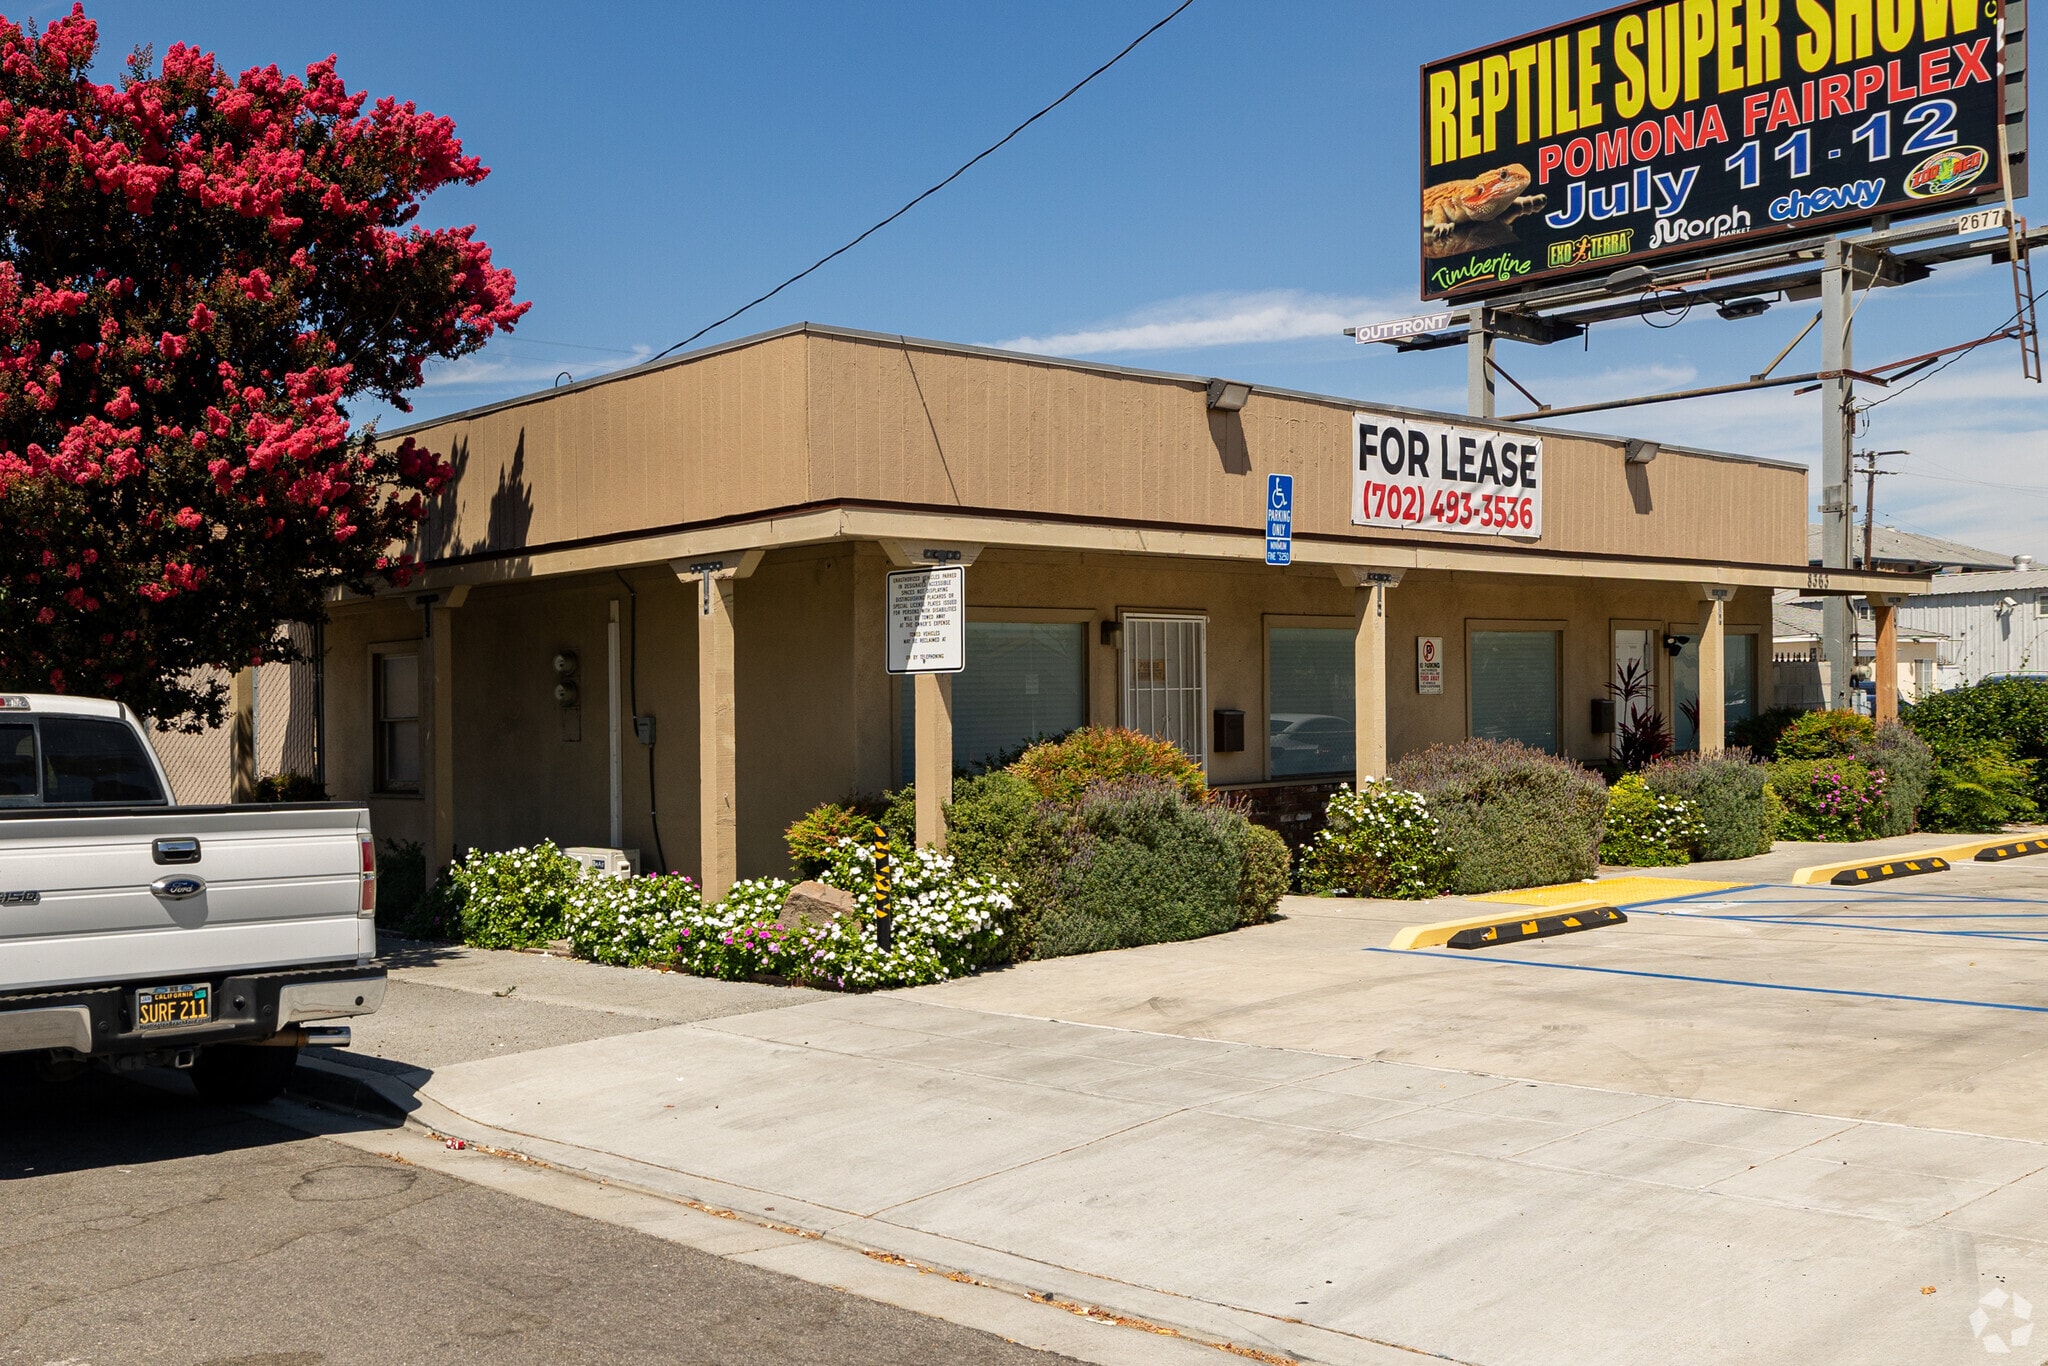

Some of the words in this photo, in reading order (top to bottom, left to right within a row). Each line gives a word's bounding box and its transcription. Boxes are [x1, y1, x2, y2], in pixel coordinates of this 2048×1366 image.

[1430, 24, 1602, 166] REPTILE
[1614, 0, 1782, 119] SUPER
[1539, 104, 1729, 185] POMONA
[1743, 37, 1992, 137] FAIRPLEX
[1911, 164, 1940, 189] ZOO
[1545, 165, 1700, 229] July
[1768, 177, 1886, 221] chewy
[1649, 204, 1751, 249] Morph
[1720, 227, 1751, 237] MARKET
[1960, 210, 2000, 231] 2677
[1550, 244, 1572, 266] EXO
[1590, 232, 1629, 258] TERRA
[1431, 253, 1532, 289] Timberline
[1359, 315, 1448, 340] OUTFRONT
[1359, 423, 1430, 478] FOR
[1441, 434, 1537, 489] LEASE
[1268, 509, 1291, 522] PARKING
[1363, 480, 1425, 523] (702)
[1429, 489, 1533, 530] 493-3536
[1271, 523, 1286, 536] ONLY
[170, 882, 194, 893] Ford
[154, 991, 194, 1000] CALIFORNIA
[140, 1001, 177, 1024] SURF
[180, 999, 208, 1020] 211
